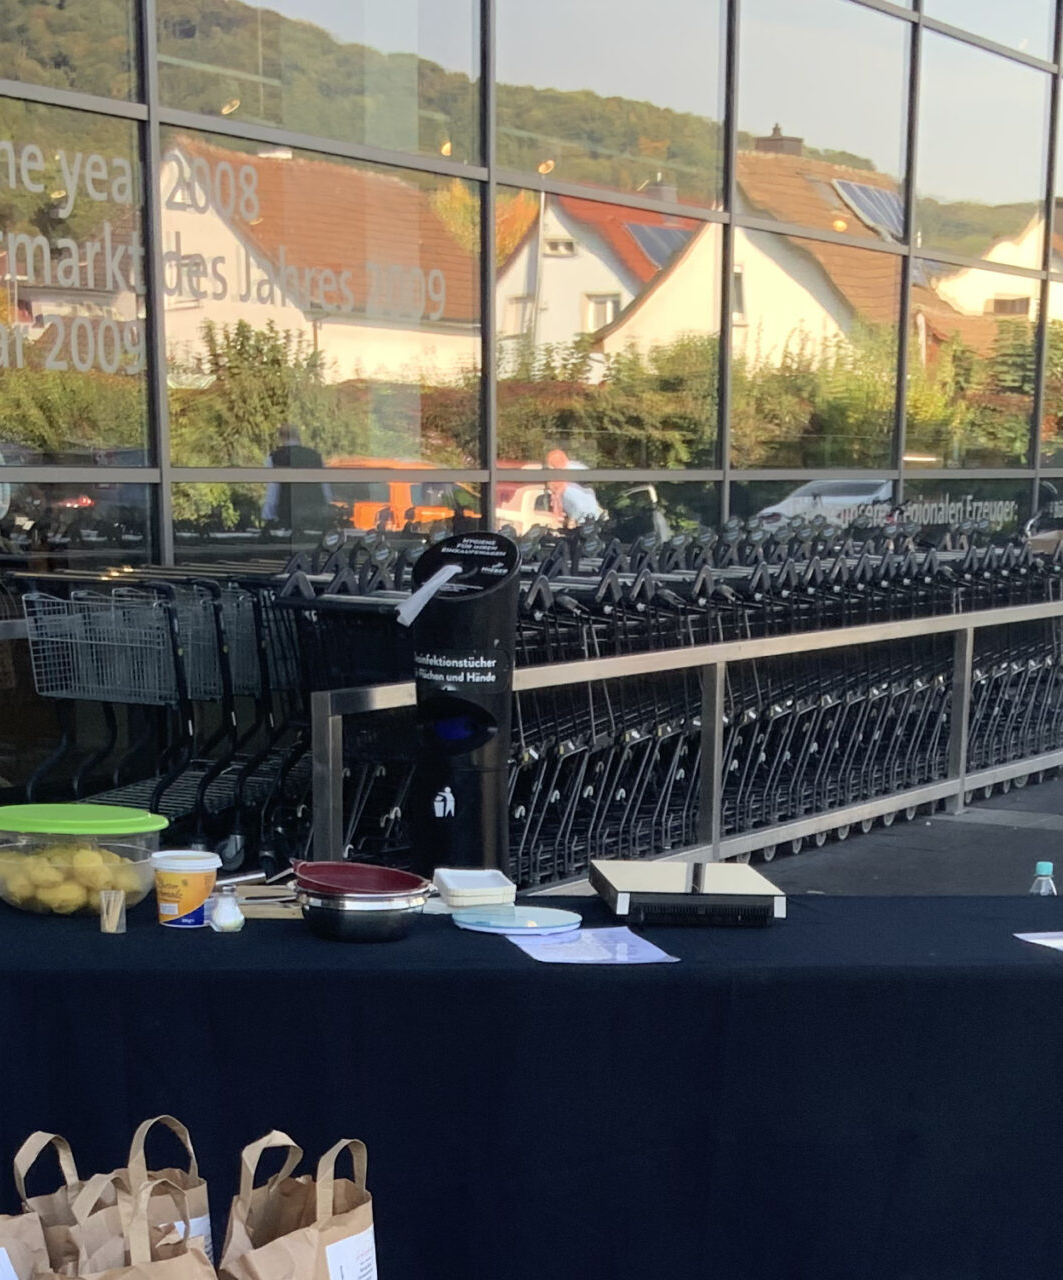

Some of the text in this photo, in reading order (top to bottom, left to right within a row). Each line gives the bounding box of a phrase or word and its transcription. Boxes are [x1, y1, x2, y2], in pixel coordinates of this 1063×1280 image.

[58, 151, 138, 218] yea
[163, 152, 261, 222] 2008
[162, 230, 228, 302] des
[239, 245, 355, 313] Jahres
[365, 262, 447, 321] 2009
[43, 313, 147, 376] 2009
[445, 671, 465, 683] und
[466, 671, 497, 683] Hände
